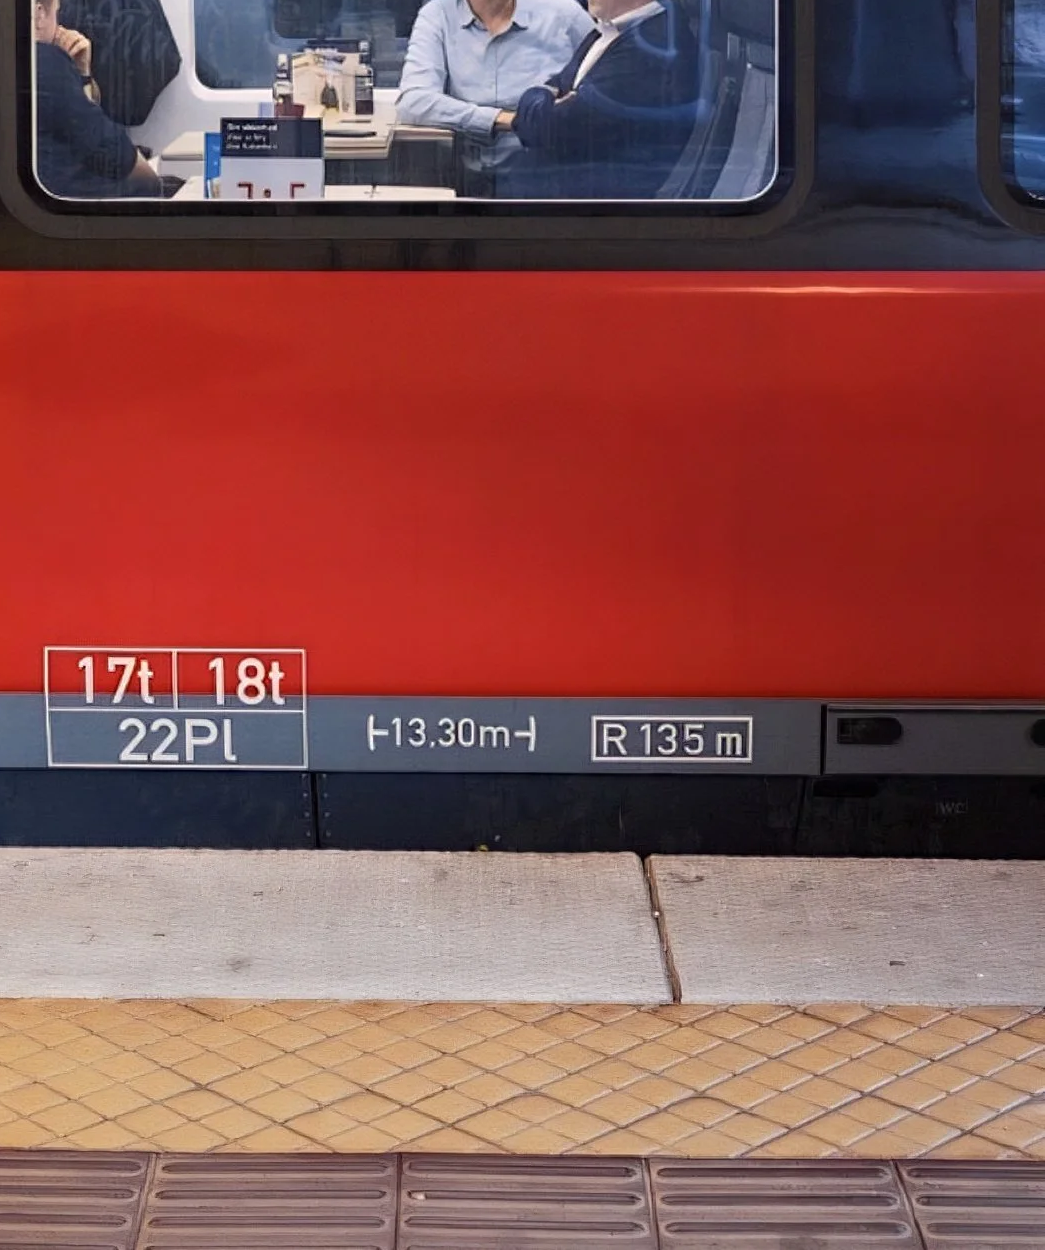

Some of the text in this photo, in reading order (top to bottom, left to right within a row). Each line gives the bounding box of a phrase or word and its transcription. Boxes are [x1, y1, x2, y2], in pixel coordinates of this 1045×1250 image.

[78, 656, 155, 704] 17t
[208, 657, 285, 705] 18t
[603, 723, 742, 756] R 135 m
